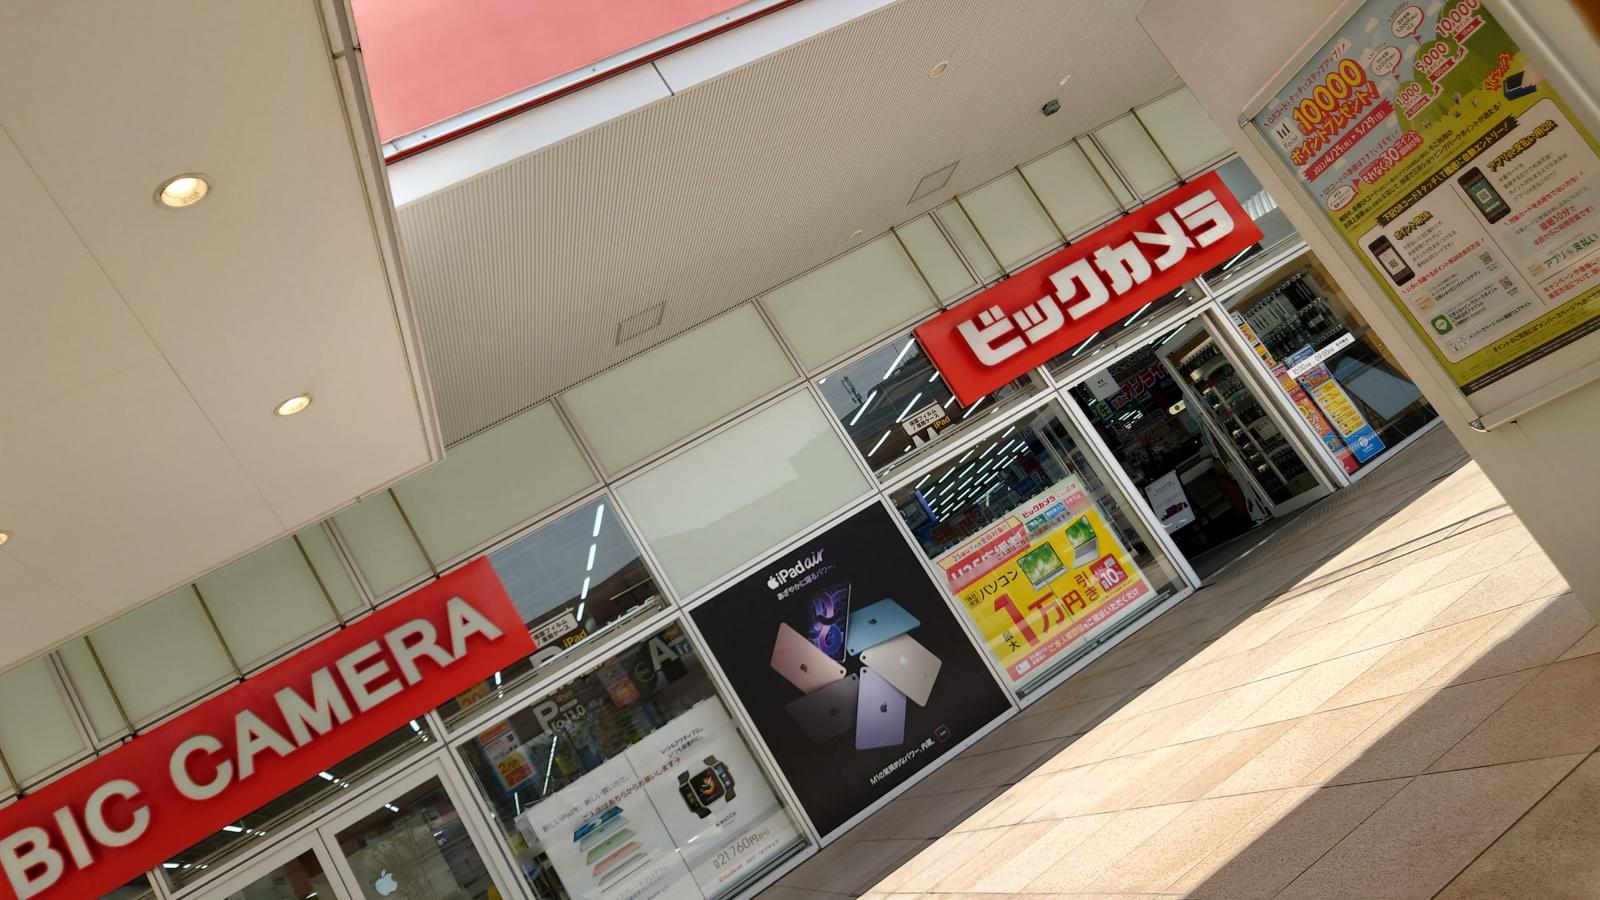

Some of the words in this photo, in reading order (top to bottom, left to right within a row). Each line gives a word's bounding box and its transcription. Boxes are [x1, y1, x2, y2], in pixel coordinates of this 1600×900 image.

[1415, 43, 1446, 71] 5,000
[1396, 83, 1420, 105] 1,000
[1283, 135, 1299, 149] Point
[956, 189, 1235, 366] ビックカメラ
[933, 416, 950, 430] iPad
[776, 561, 806, 585] iPad
[804, 549, 825, 569] air
[980, 569, 1018, 600] パソコン
[563, 628, 588, 647] iPad
[1, 779, 151, 900] BIC
[169, 595, 504, 801] CAMERA
